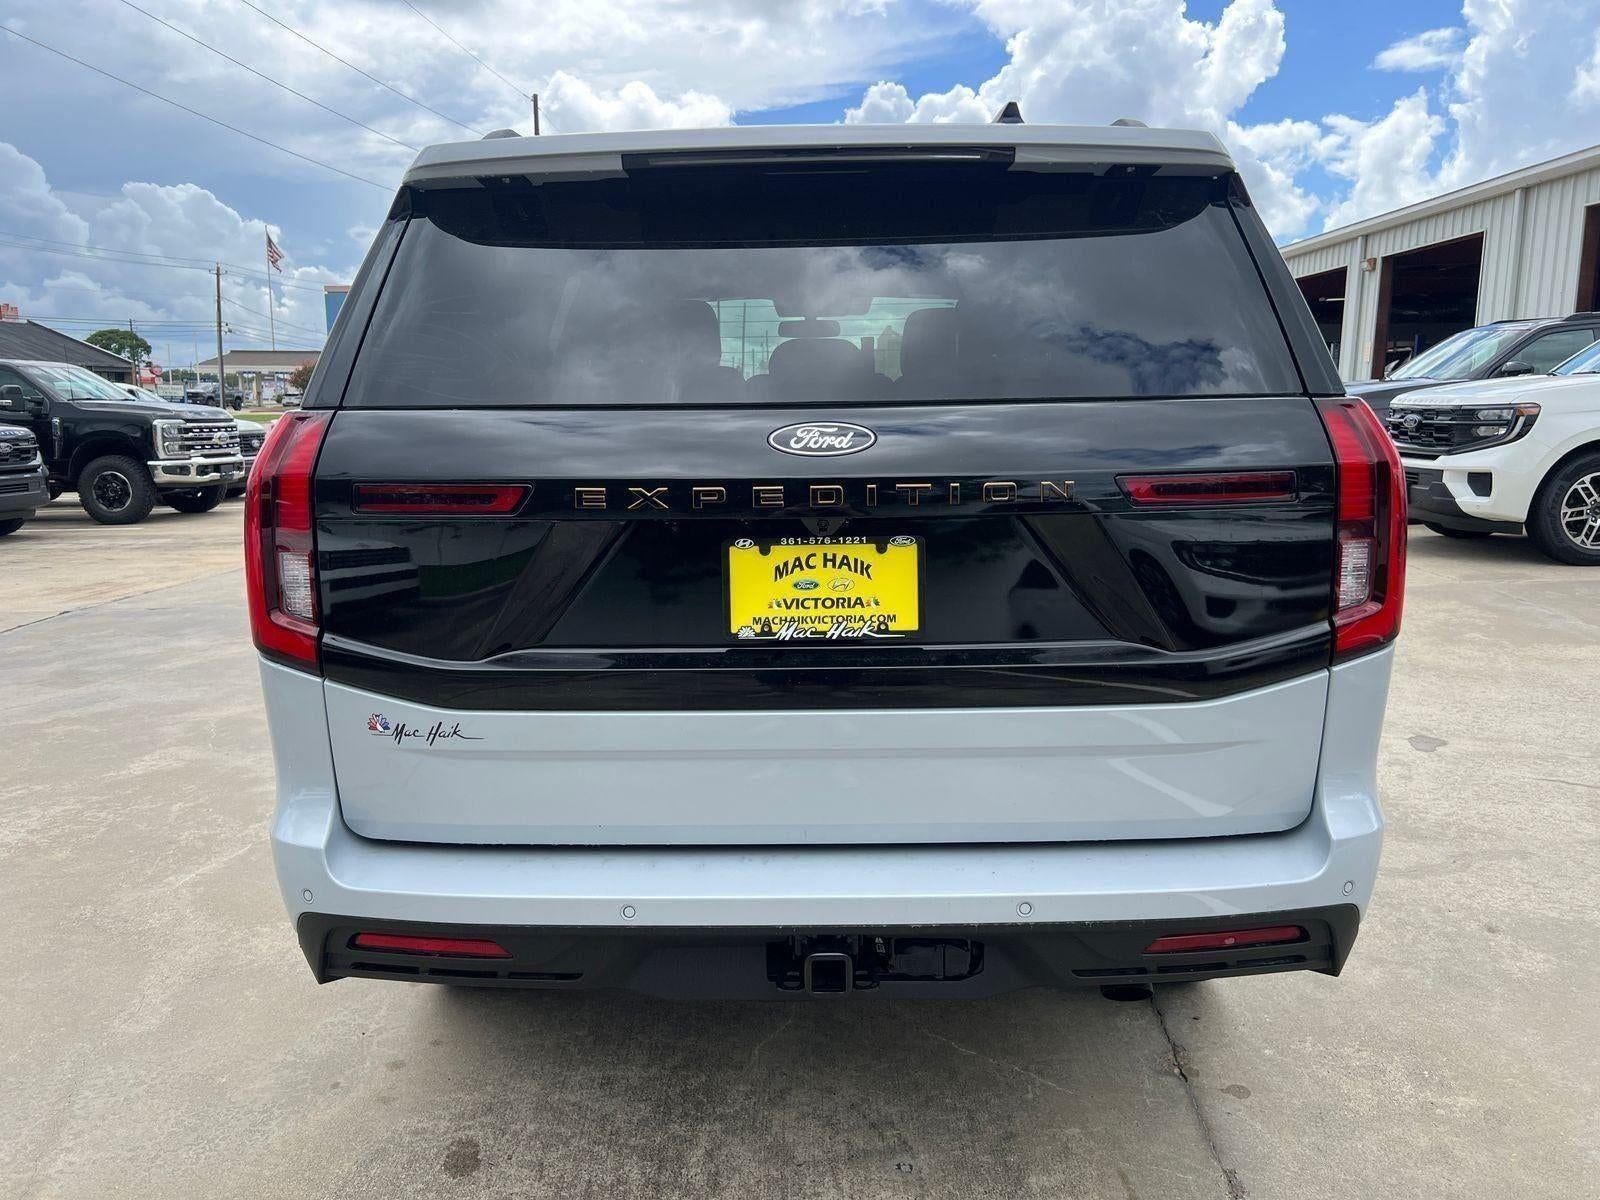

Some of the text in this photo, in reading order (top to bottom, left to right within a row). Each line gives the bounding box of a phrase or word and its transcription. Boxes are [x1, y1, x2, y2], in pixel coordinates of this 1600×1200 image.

[788, 425, 857, 452] Ford
[574, 480, 1076, 510] EXPEDITION
[780, 536, 868, 545] 361-576-1221
[773, 552, 873, 582] MAC HAIK
[796, 581, 815, 590] Ford
[781, 596, 866, 610] VICTORIA
[752, 614, 897, 626] MACHAIKVICTORIA.COM
[771, 620, 893, 640] Mac Haik
[390, 721, 476, 747] Mac Haik
